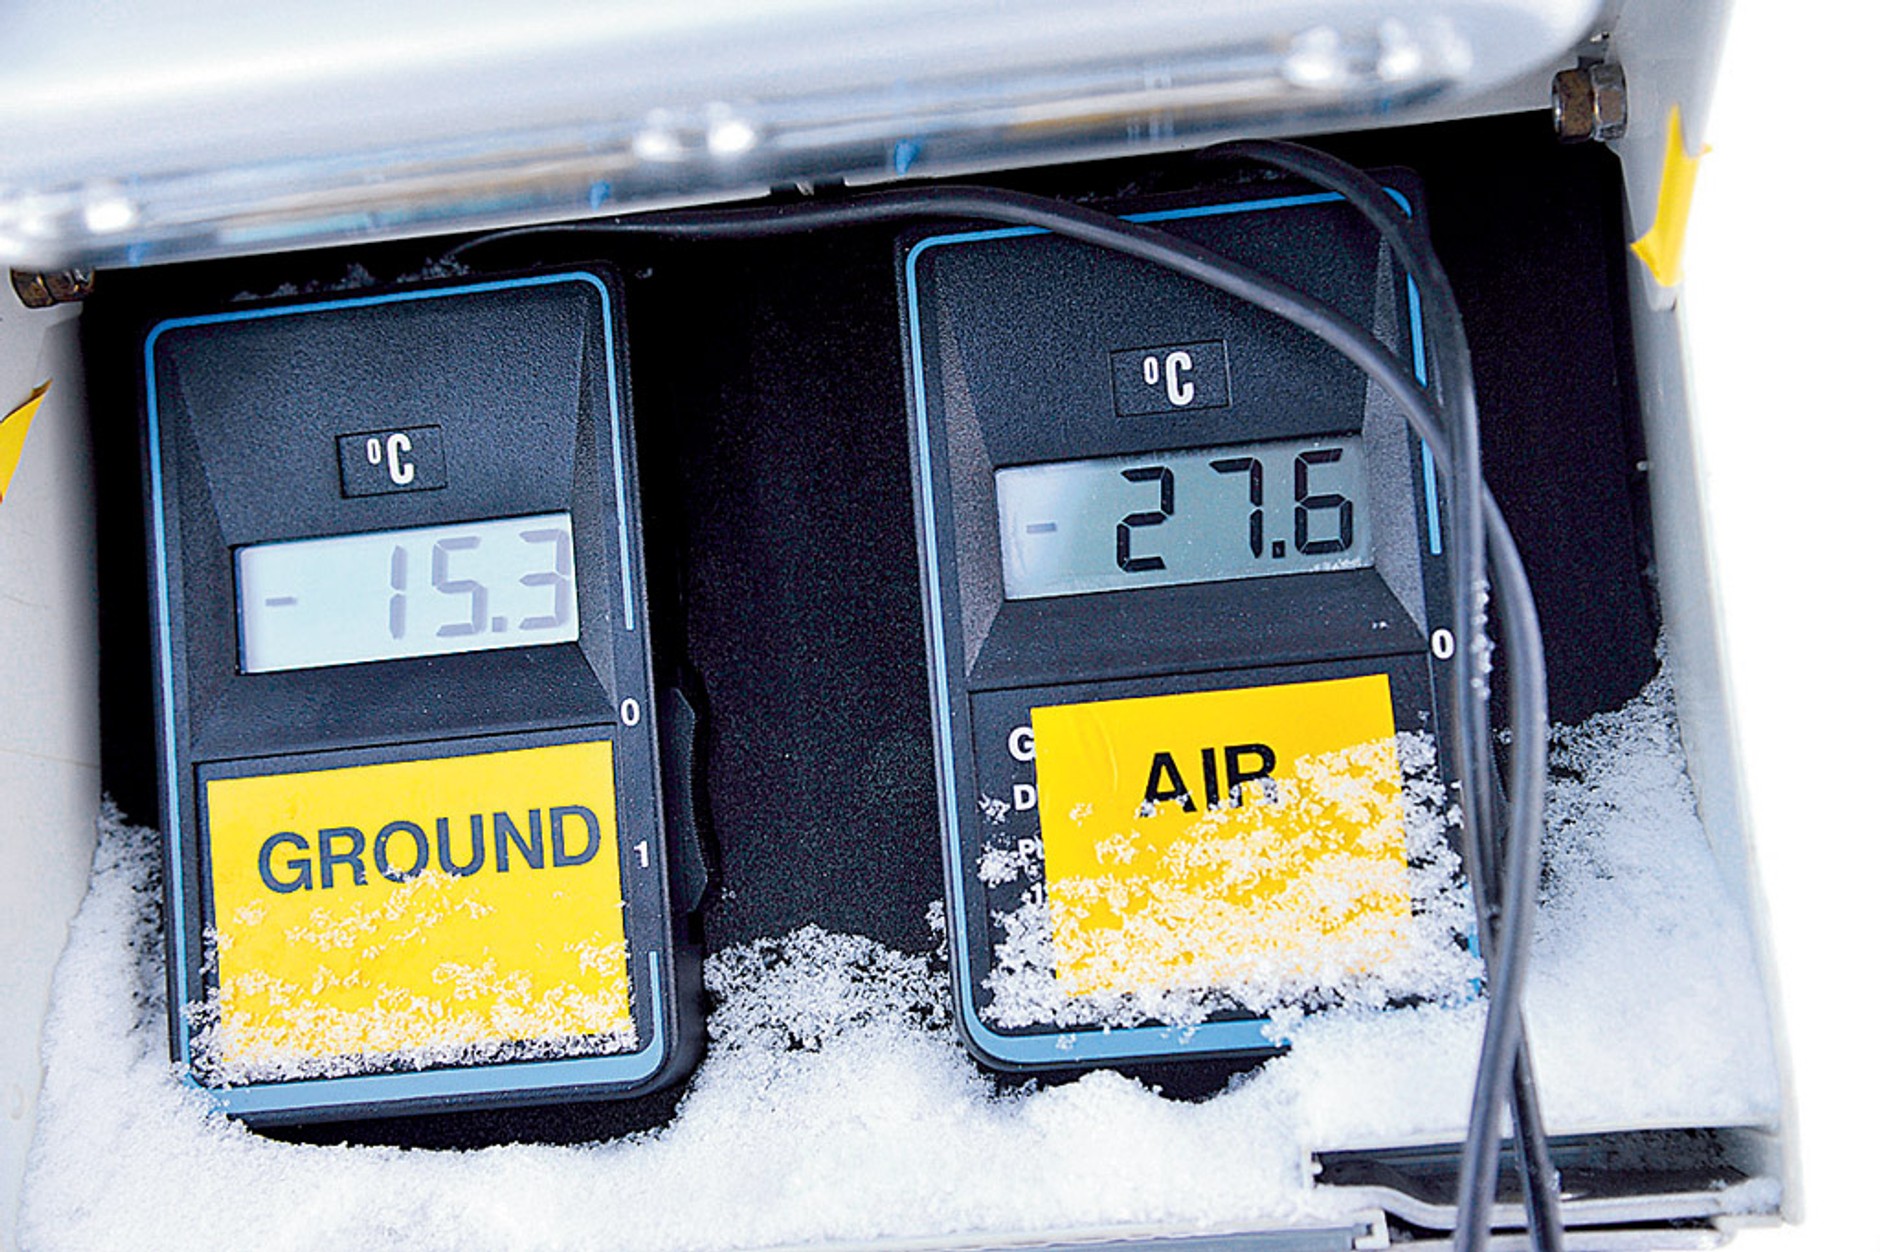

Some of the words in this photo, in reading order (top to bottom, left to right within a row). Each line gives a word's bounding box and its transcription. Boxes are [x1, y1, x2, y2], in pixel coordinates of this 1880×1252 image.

[1138, 742, 1278, 818] AIR
[259, 805, 601, 894] GROUND
[633, 840, 650, 867] 1
